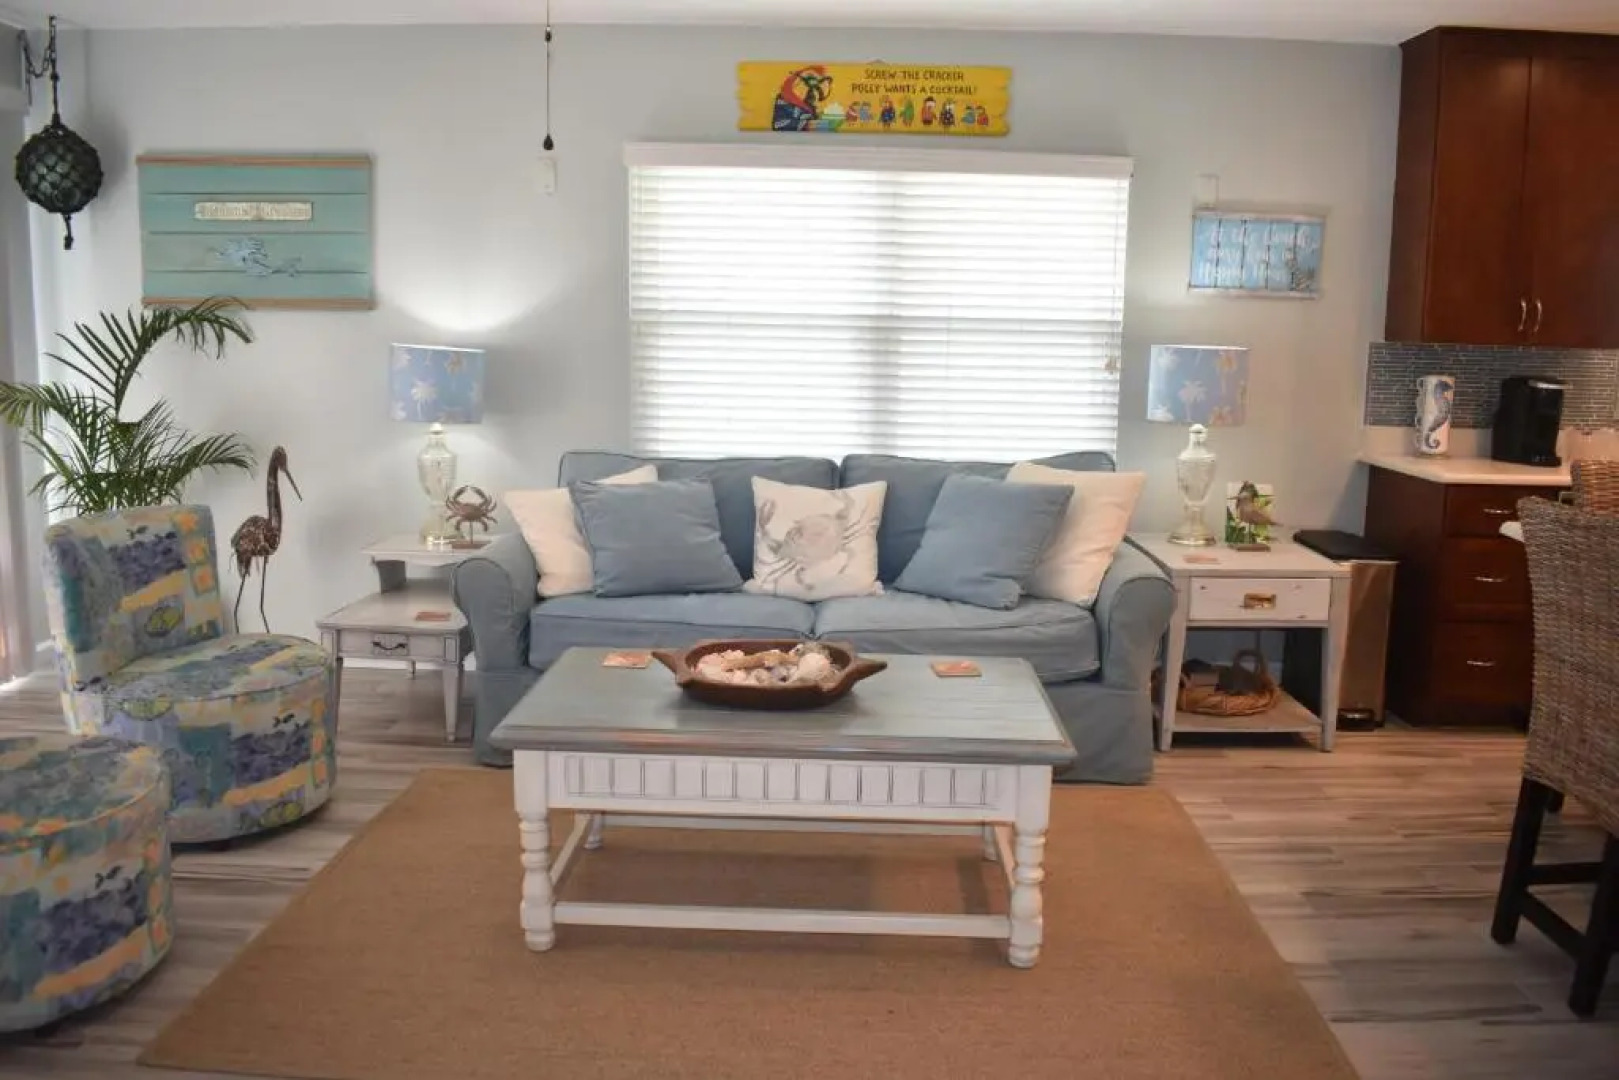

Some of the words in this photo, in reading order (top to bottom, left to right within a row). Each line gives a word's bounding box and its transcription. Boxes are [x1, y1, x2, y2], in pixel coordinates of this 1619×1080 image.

[864, 68, 896, 80] SCREW
[899, 70, 920, 80] THE
[923, 70, 964, 81] CRACKER
[851, 83, 881, 94] POLLY
[884, 84, 916, 94] WANTS
[919, 86, 926, 94] A
